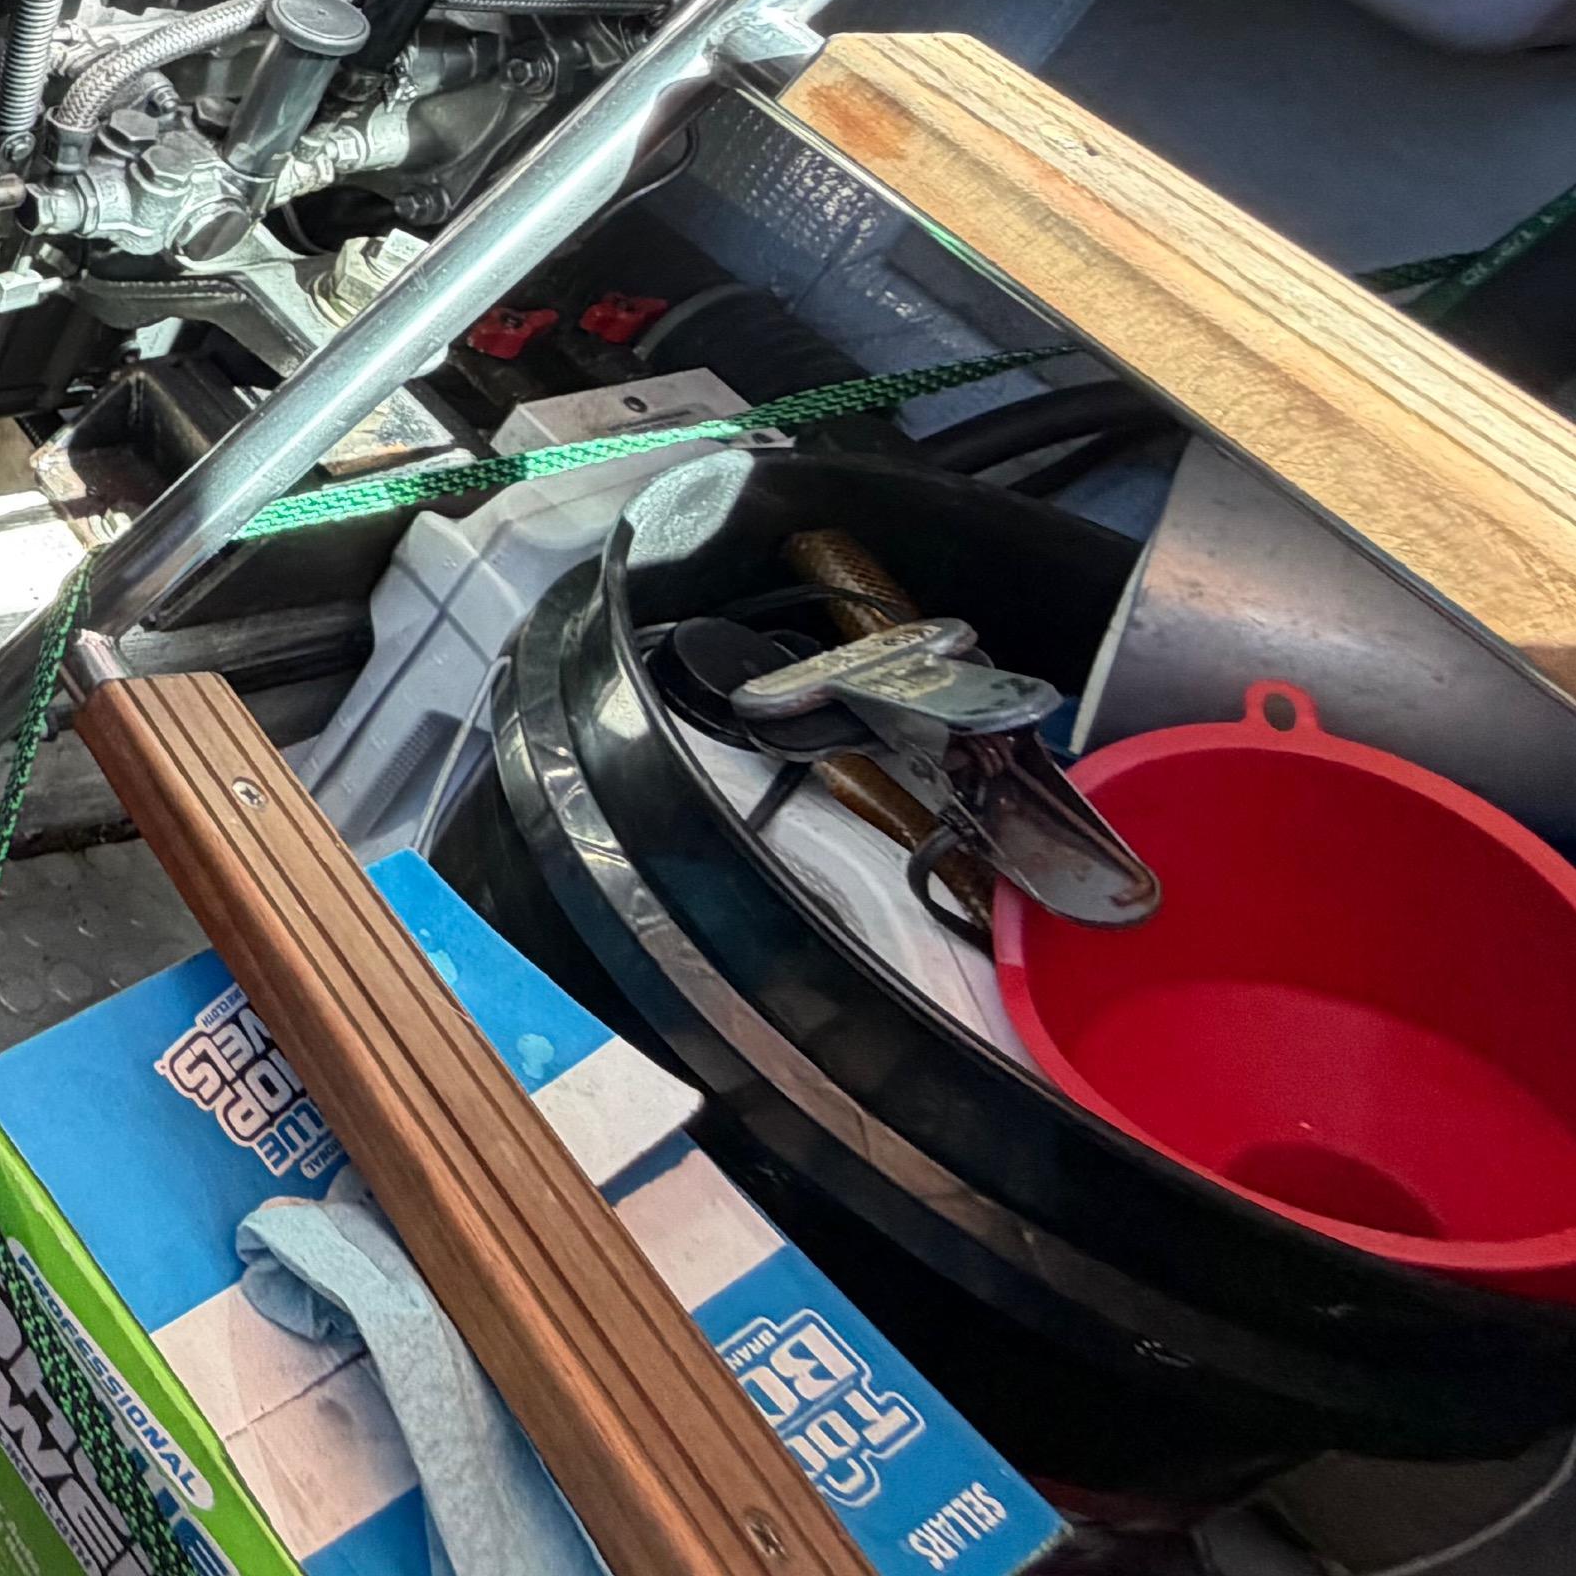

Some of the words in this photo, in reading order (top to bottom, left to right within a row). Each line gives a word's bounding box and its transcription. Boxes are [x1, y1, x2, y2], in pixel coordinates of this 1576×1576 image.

[256, 1102, 325, 1172] LUE
[16, 1253, 198, 1497] PROFESSIONAL
[725, 1328, 778, 1372] BRAN
[736, 1323, 858, 1428] BO
[907, 1481, 1008, 1572] SELLARS
